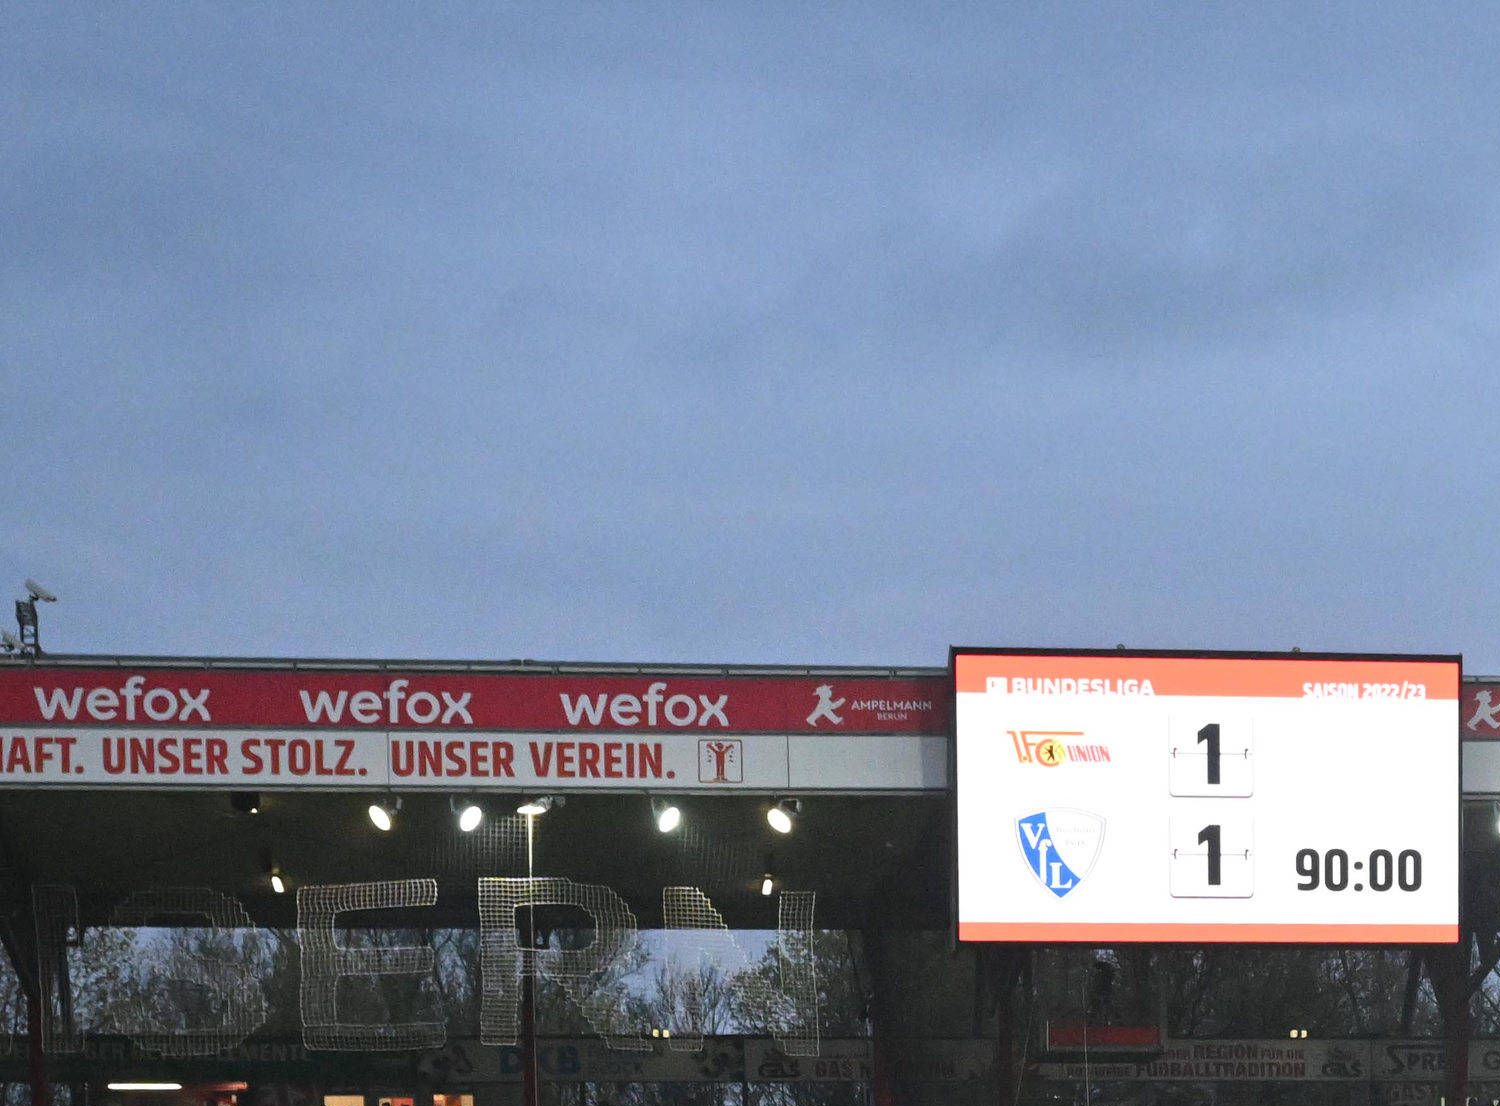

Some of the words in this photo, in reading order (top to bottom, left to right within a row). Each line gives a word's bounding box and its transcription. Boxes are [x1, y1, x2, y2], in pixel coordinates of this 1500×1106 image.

[34, 676, 211, 721] wefox
[299, 679, 473, 725] wefox
[560, 682, 729, 727] wefox
[851, 699, 932, 711] AMPELMANN
[1012, 678, 1155, 696] BUNDESLIGA
[1302, 682, 1360, 699] SAISON
[1363, 681, 1427, 700] 2022/23
[0, 736, 85, 775] AFT.
[102, 737, 229, 776] UNSER
[241, 738, 368, 777] STOLZ.
[392, 740, 515, 778] UNSER
[529, 741, 676, 779] VEREIN.
[1197, 723, 1221, 785] 1
[1198, 825, 1221, 886] 1
[1295, 848, 1422, 892] 90:00
